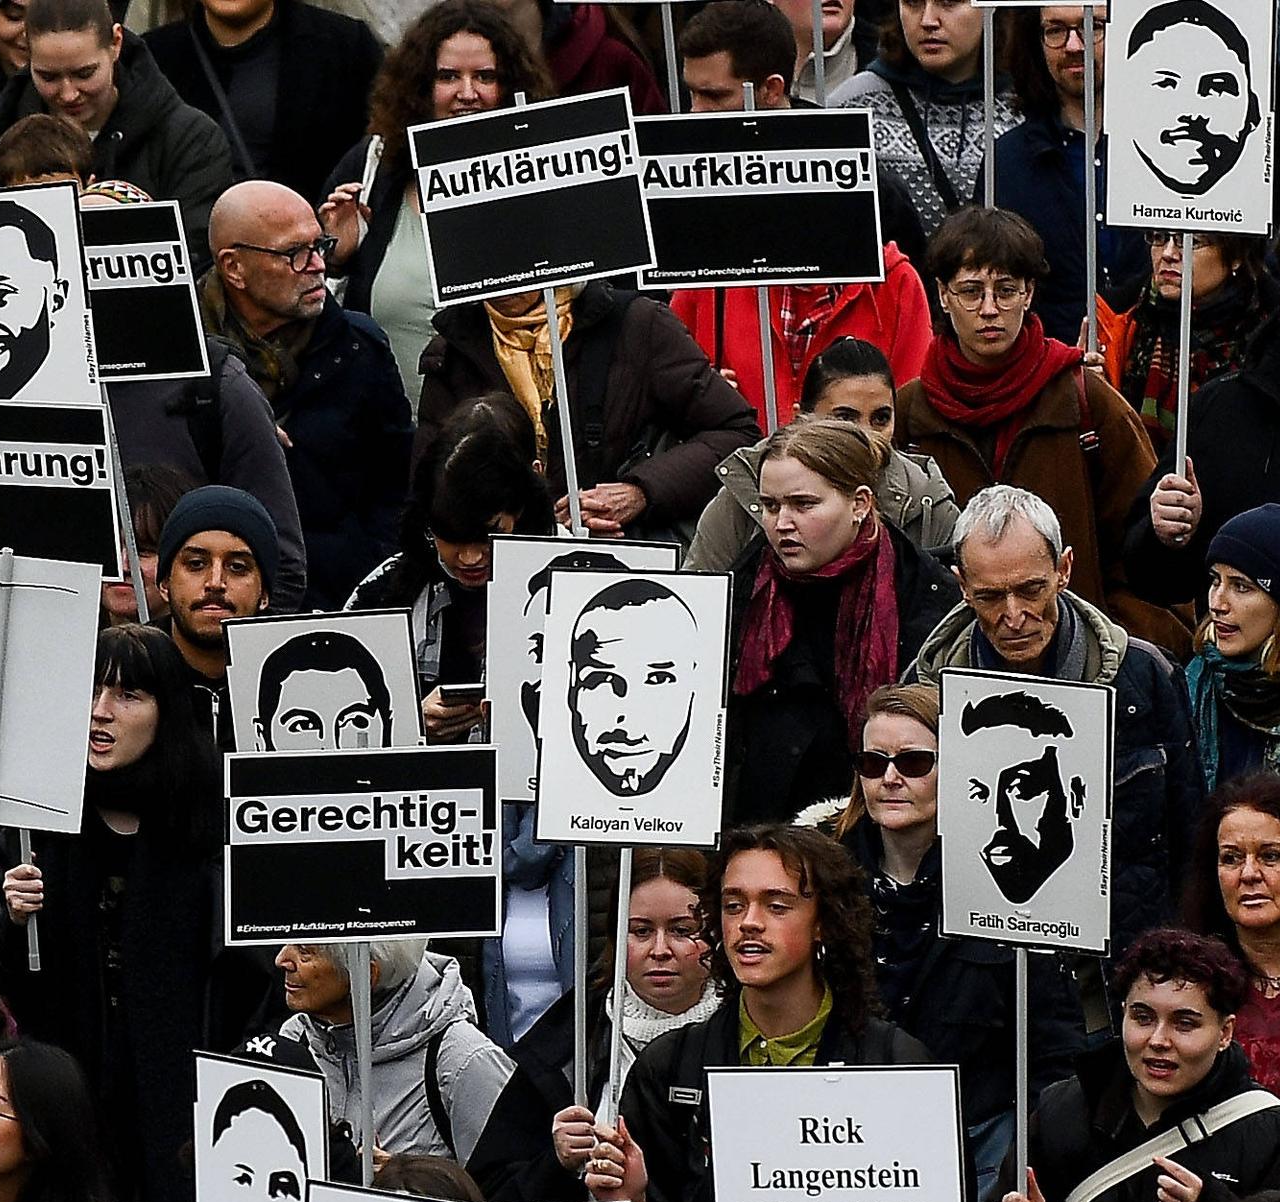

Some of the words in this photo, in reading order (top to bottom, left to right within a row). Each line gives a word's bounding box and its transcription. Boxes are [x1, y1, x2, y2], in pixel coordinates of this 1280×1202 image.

[426, 134, 634, 202] Aufklärung!
[643, 151, 871, 190] Aufklärung!
[1133, 204, 1181, 219] Hamza
[1186, 206, 1243, 222] Kurtović
[235, 794, 478, 834] Gerechtig-
[569, 814, 631, 832] Kaloyan
[634, 815, 683, 833] Velkov
[396, 833, 494, 869] keit!
[969, 912, 1004, 929] Fatih
[1007, 917, 1079, 938] Saraçoğlu
[799, 1116, 864, 1145] Rick
[751, 1161, 921, 1196] Langenstein
